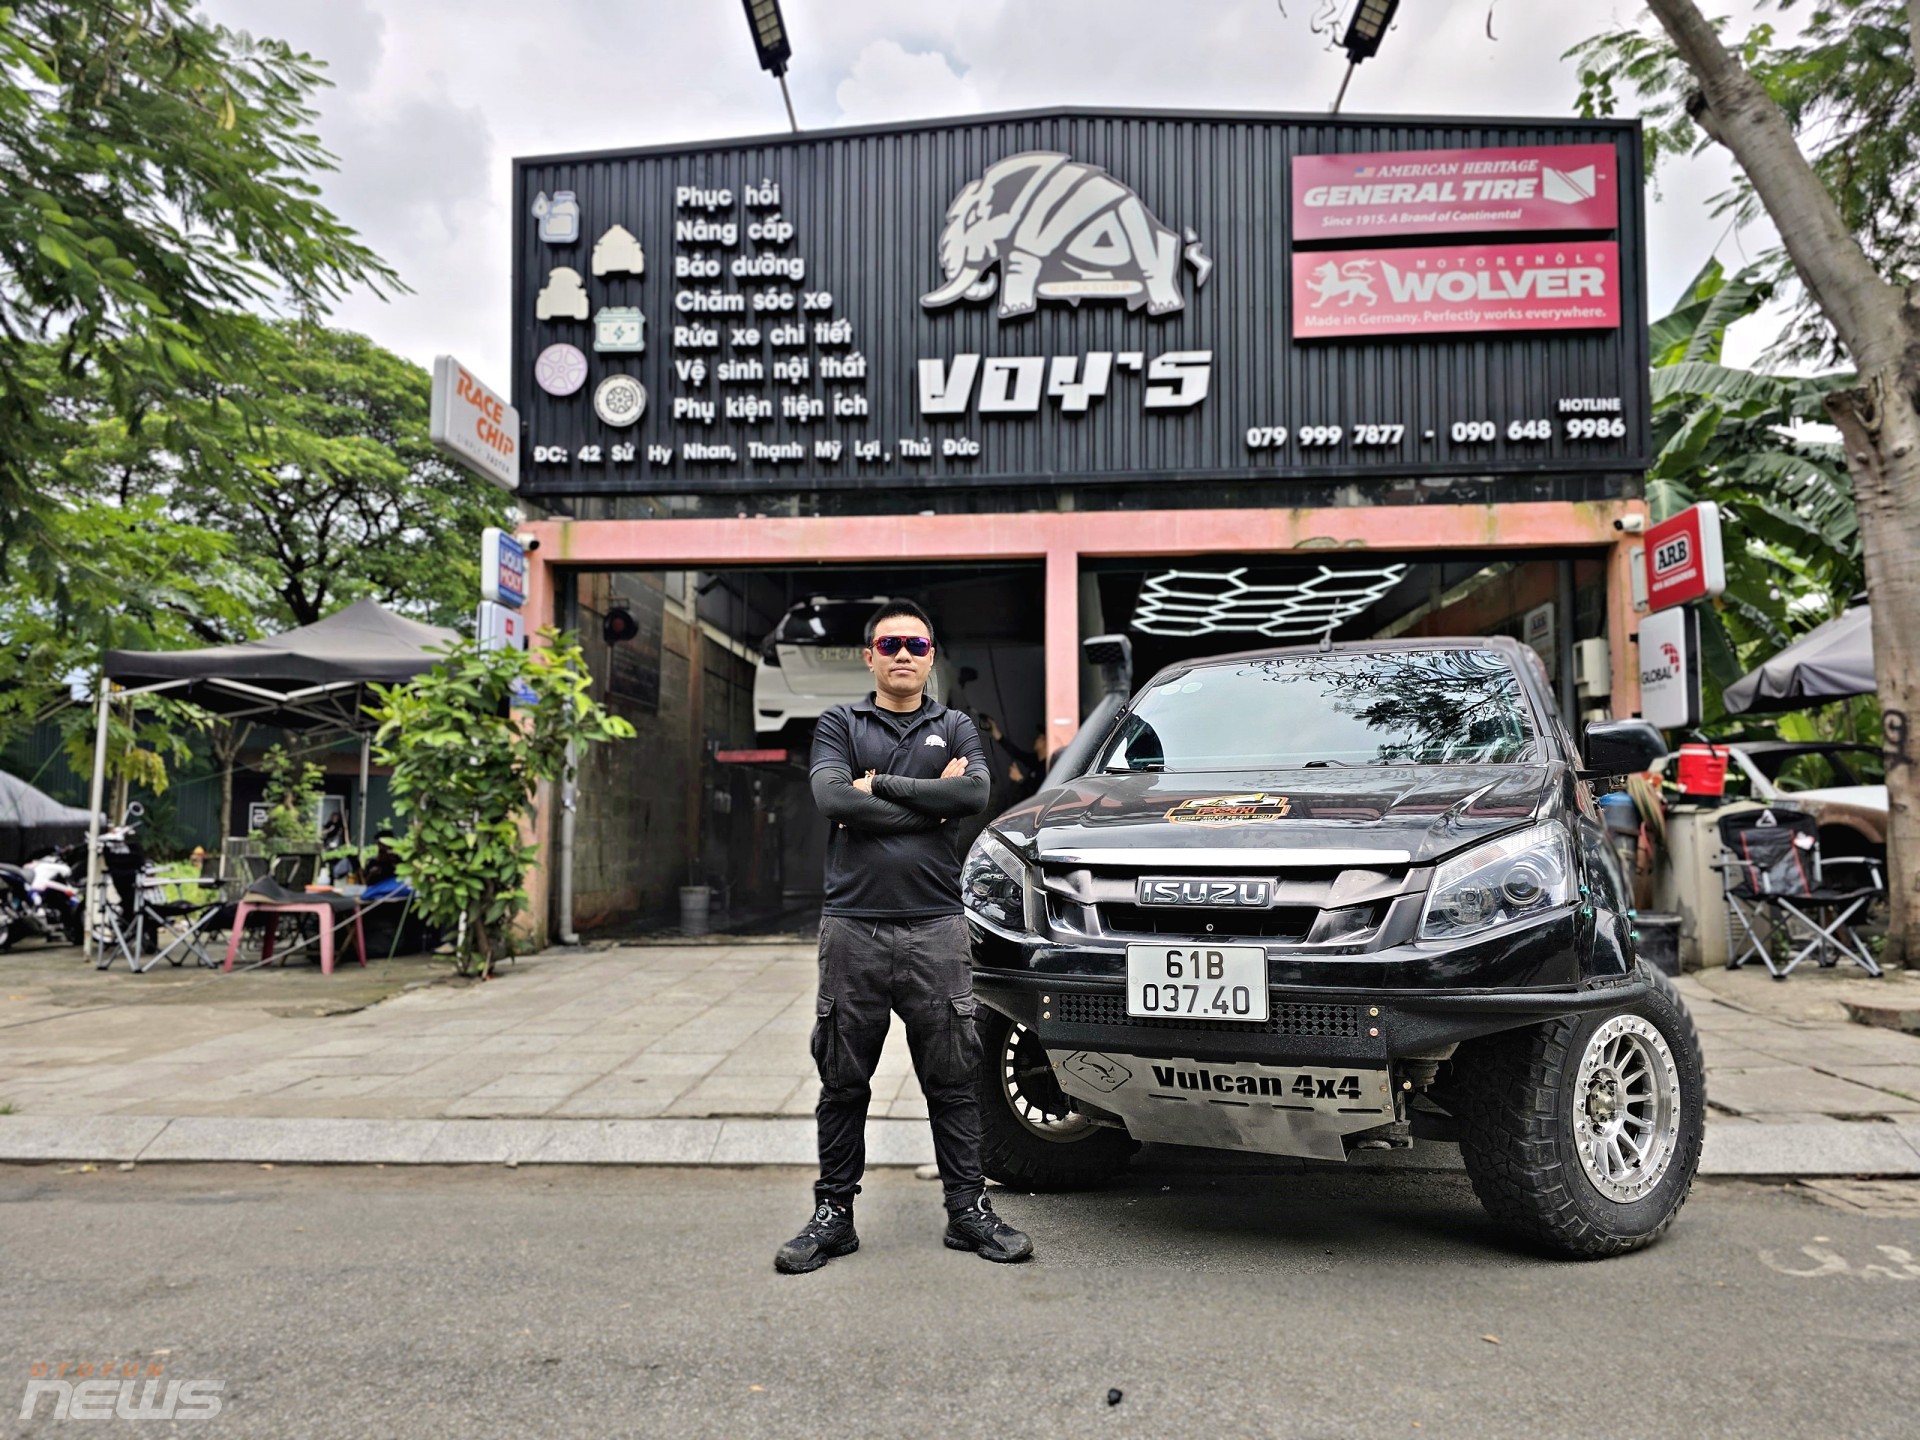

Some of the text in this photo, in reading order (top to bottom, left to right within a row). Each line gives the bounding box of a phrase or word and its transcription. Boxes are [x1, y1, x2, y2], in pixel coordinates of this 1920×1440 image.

[1377, 159, 1539, 178] AMERICAN HERITAGE
[676, 178, 781, 211] Phục hồi
[1304, 178, 1538, 207] GENERAL TIRE
[676, 214, 794, 246] Nâng cấp
[1321, 208, 1522, 227] Since 1915. A Brand of Continental
[676, 253, 805, 281] Bảo dưỡng
[1380, 260, 1605, 303] WOLVER
[675, 287, 833, 312] Chăm sóc xe
[1304, 307, 1606, 328] Made in Germany. Perfectly works everywhere.
[674, 318, 853, 348] Rửa xe chi tiết
[675, 355, 867, 387] Vệ sinh nội thất
[918, 350, 1213, 414] VOY'S
[456, 367, 504, 425] RACE
[674, 394, 868, 425] Phụ kiện tiện ích
[1559, 398, 1621, 412] HOTLINE
[476, 417, 514, 456] CHIP
[1246, 427, 1287, 448] 079
[1300, 426, 1343, 446] 999
[1354, 425, 1405, 444] 7877
[1452, 421, 1496, 442] 090
[1507, 420, 1553, 440] 648
[1566, 418, 1626, 439] 9986
[533, 445, 569, 462] ĐC:
[578, 445, 601, 462] 42
[611, 442, 635, 462] Sử
[648, 445, 673, 465] Hy
[683, 442, 738, 463] Nhan,
[747, 441, 803, 462] Thạnh
[815, 438, 843, 462] Mỹ
[900, 436, 932, 456] Thủ
[942, 437, 980, 456] Đức
[1657, 540, 1688, 571] ARB
[1641, 665, 1672, 685] GLOBAL
[1143, 881, 1268, 905] ISUZU
[1166, 951, 1225, 980] 61B
[1143, 983, 1250, 1015] 037.40
[1151, 1065, 1362, 1100] Vulcan 4x4
